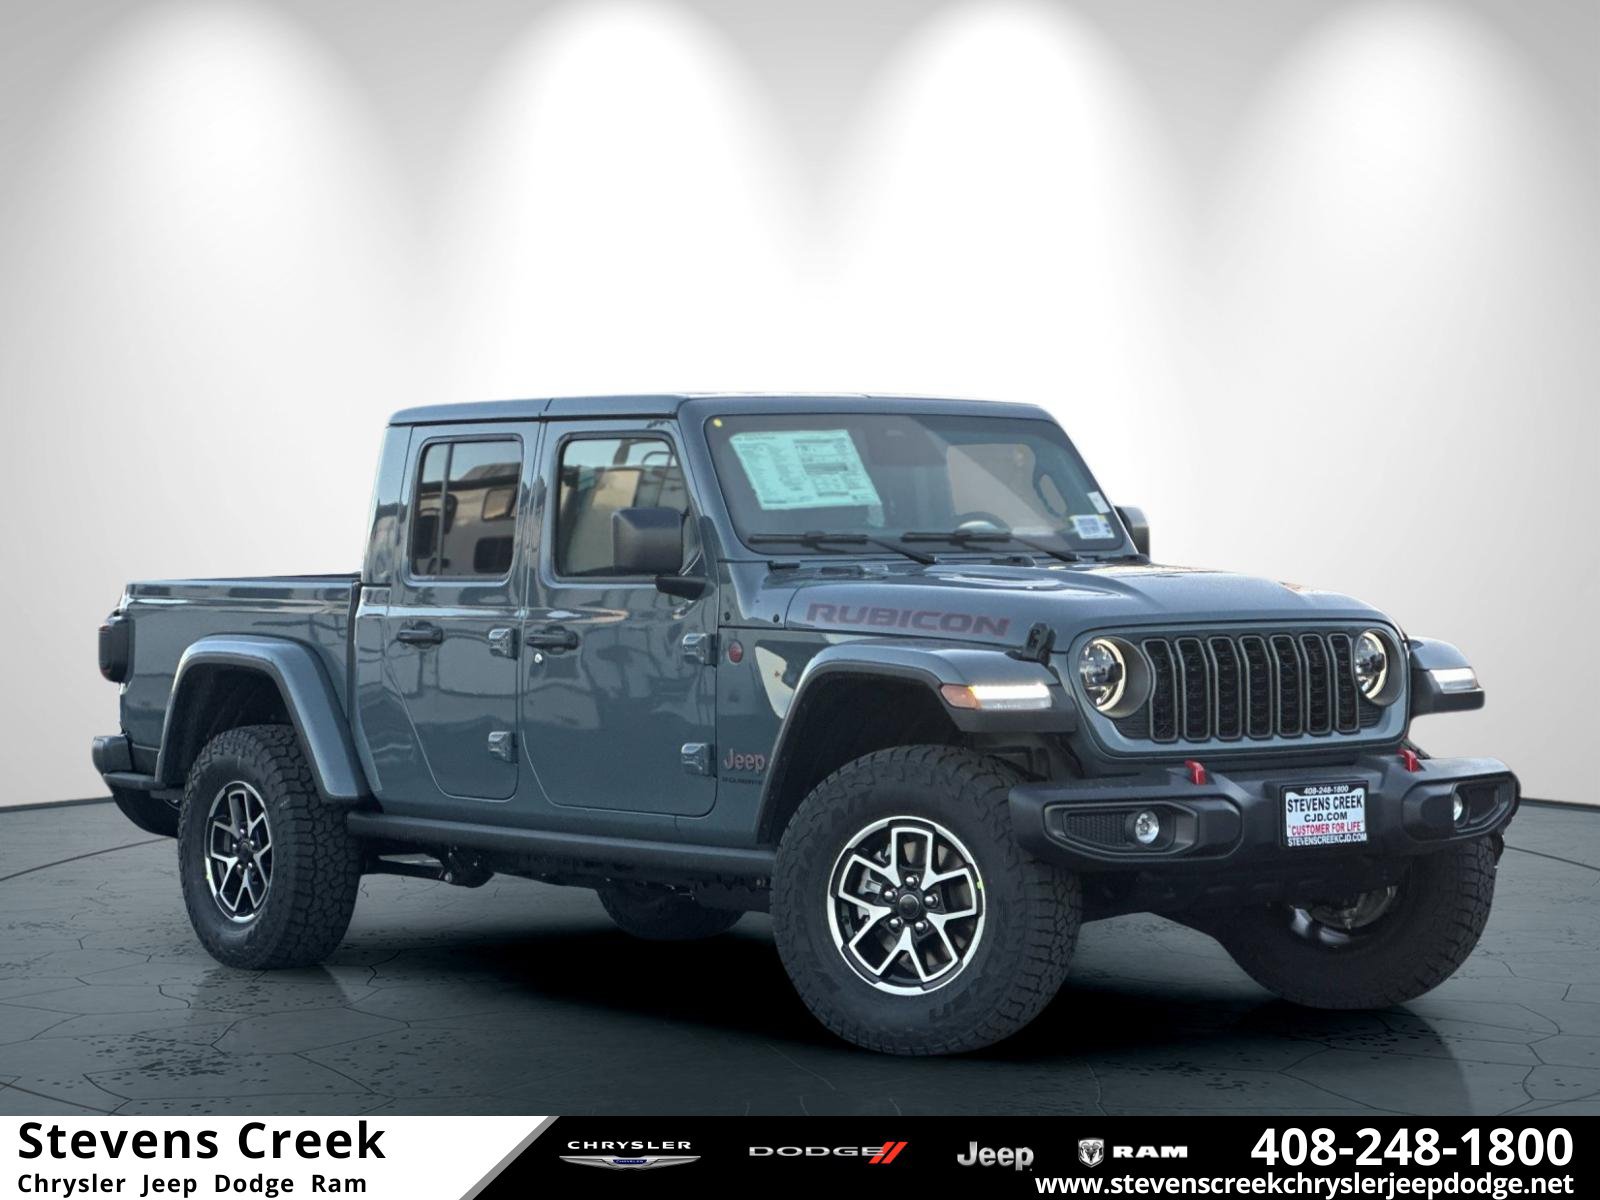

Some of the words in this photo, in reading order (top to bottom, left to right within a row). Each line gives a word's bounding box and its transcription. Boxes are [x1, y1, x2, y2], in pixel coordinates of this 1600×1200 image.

[806, 603, 1010, 637] RUBICON
[723, 748, 766, 774] Jeep
[1304, 785, 1348, 794] 408-248-1800
[1288, 797, 1330, 812] STEVENS
[1333, 796, 1362, 809] CREEK
[1304, 812, 1347, 822] CJD.COM
[1332, 823, 1344, 832] FOR
[1288, 833, 1367, 846] STEVENSCREEKCJD.COM
